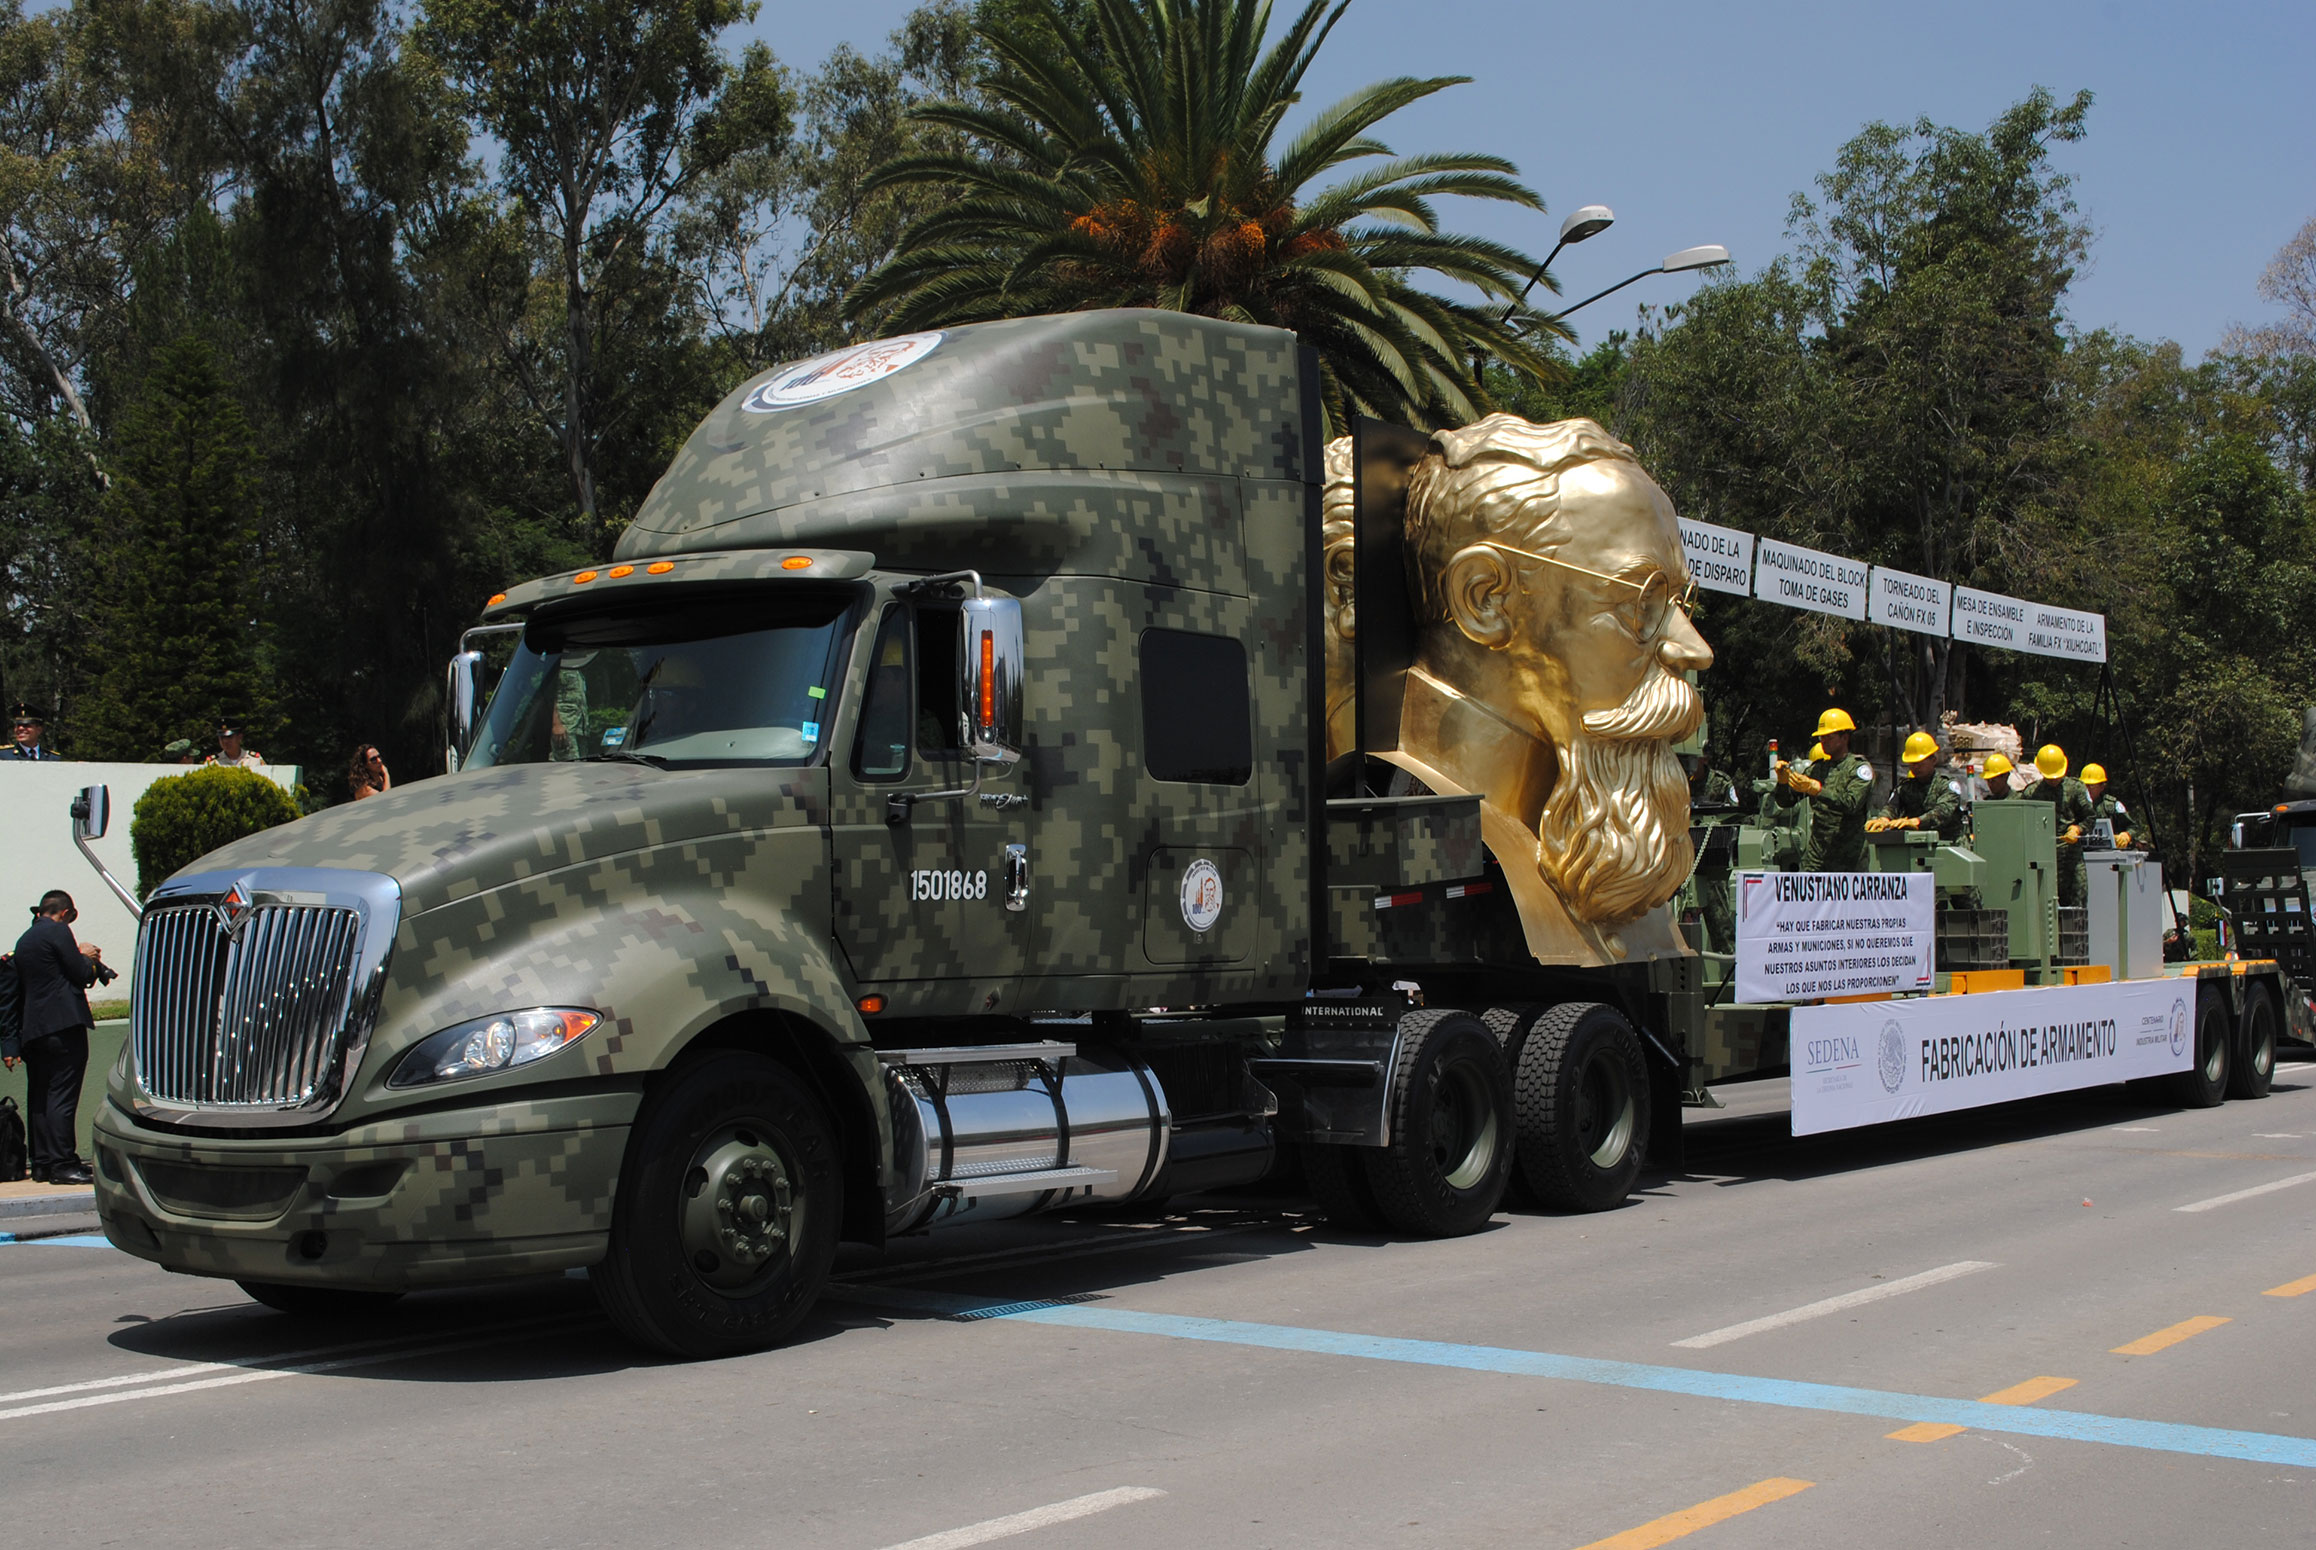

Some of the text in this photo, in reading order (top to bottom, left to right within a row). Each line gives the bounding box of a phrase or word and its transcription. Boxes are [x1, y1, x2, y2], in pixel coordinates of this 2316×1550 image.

[1712, 536, 1725, 555] DE
[1727, 540, 1739, 558] LA
[1688, 558, 1746, 586] DE DISPARO
[1762, 549, 1866, 588] MAQUINADO DEL BLOCK
[1779, 579, 1849, 608] TOMA DE GASES
[1883, 578, 1941, 605] TORNEADO DEL
[1887, 601, 1936, 627] CAÑÓN FX 05
[1957, 595, 2024, 623] MESA DE ENSAMBLE
[1967, 620, 2013, 642] E INSPECCIÓN
[2037, 613, 2094, 634] ARMAMENTO DE LA
[2028, 632, 2052, 648] FAMILIA
[2054, 637, 2062, 650] FX
[911, 870, 987, 900] 1501868
[1775, 875, 1908, 902] VENUSTIANO CARRANZA
[1776, 917, 1906, 933] "HAY QUE FABRICAR NUESTRAS PROPIAS
[1768, 936, 1913, 954] ARMAS Y MUNICIONES, SI NO QUEREMOS QUE
[1764, 955, 1916, 975] NUESTROS ASUNTOS INTERIORES LOS DECIDAN
[1786, 975, 1900, 995] LOS QUE NOS LAS PROPORCIONEN"
[1302, 1006, 1383, 1016] INTERNATIONAL
[1808, 1036, 1859, 1065] SEDENA
[1922, 1020, 2016, 1082] FABRICACIÓN
[2020, 1028, 2037, 1068] DE
[2040, 1020, 2117, 1066] ARMAMENTO
